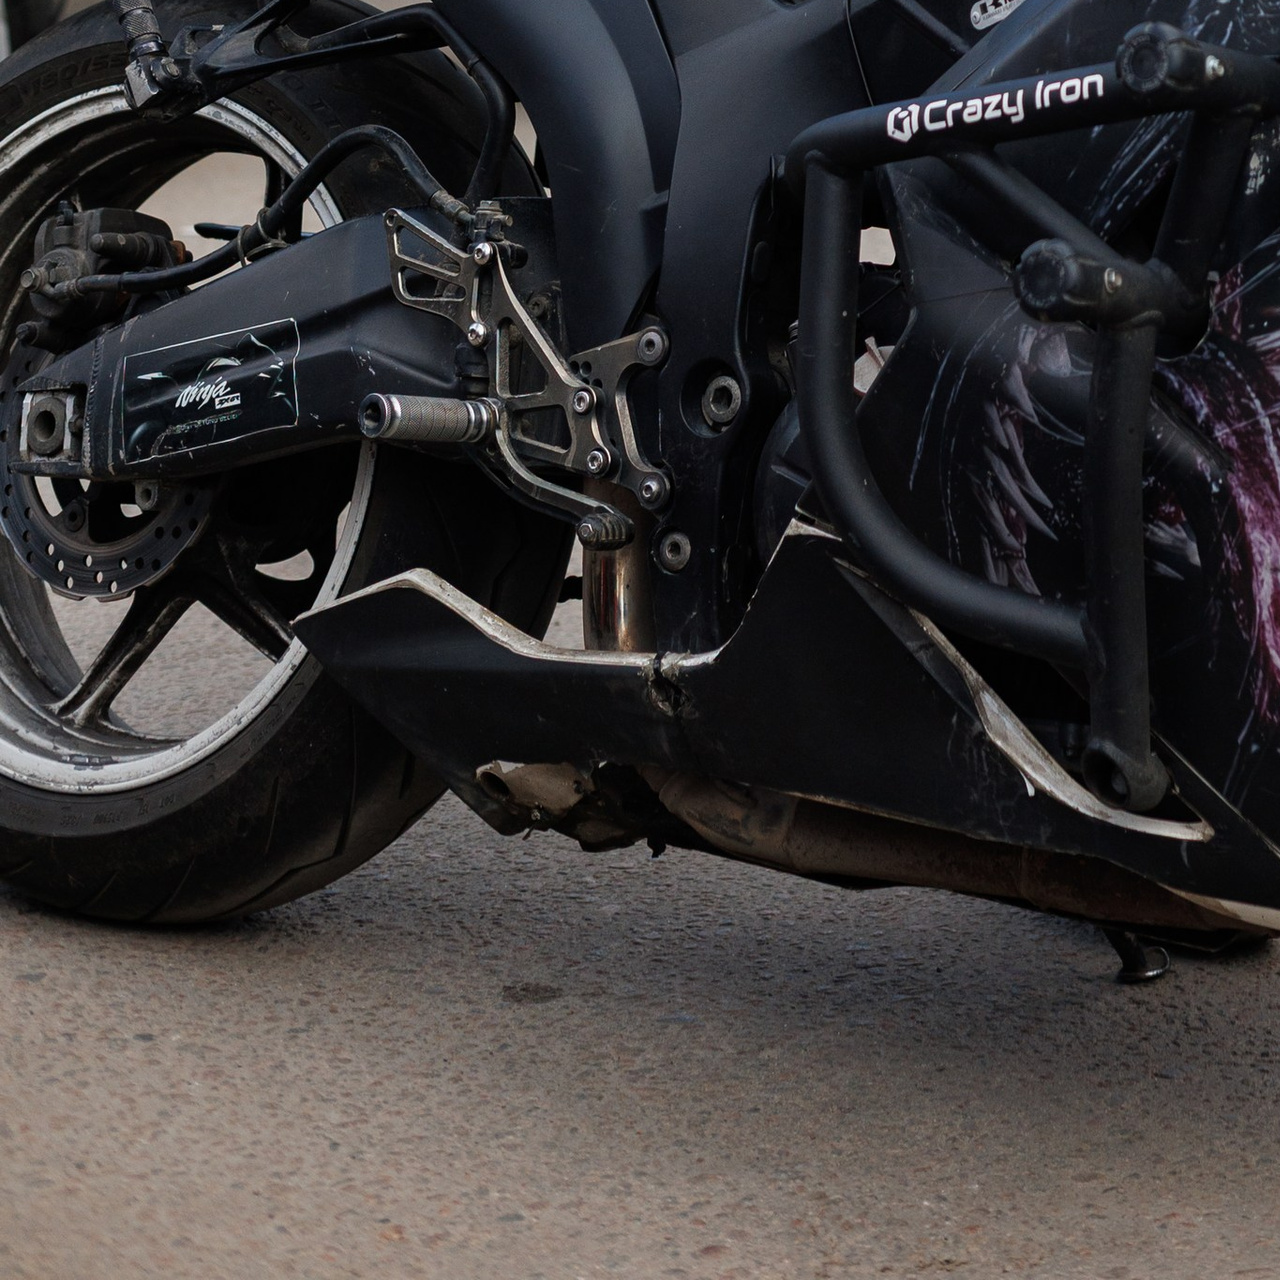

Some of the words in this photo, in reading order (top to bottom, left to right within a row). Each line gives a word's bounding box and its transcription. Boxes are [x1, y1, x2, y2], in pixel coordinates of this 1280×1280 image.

[924, 89, 1024, 132] Crazy
[1035, 73, 1104, 109] Iron
[175, 376, 231, 410] Ninja
